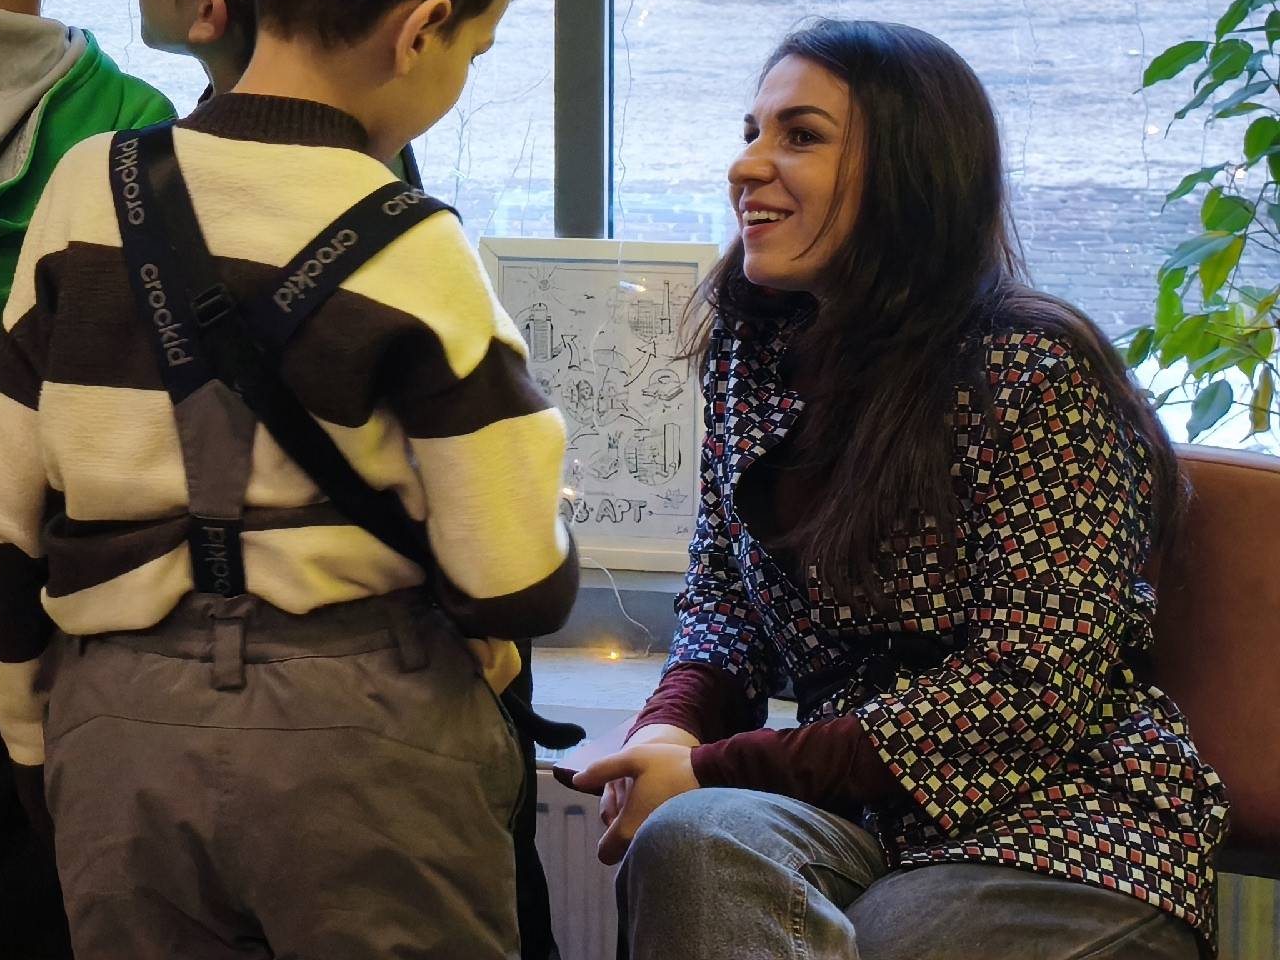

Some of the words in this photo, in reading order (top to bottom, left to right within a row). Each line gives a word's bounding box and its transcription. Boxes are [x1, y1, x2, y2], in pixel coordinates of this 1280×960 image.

[114, 137, 145, 225] crockid
[272, 228, 359, 313] crockid
[140, 263, 195, 368] crockid
